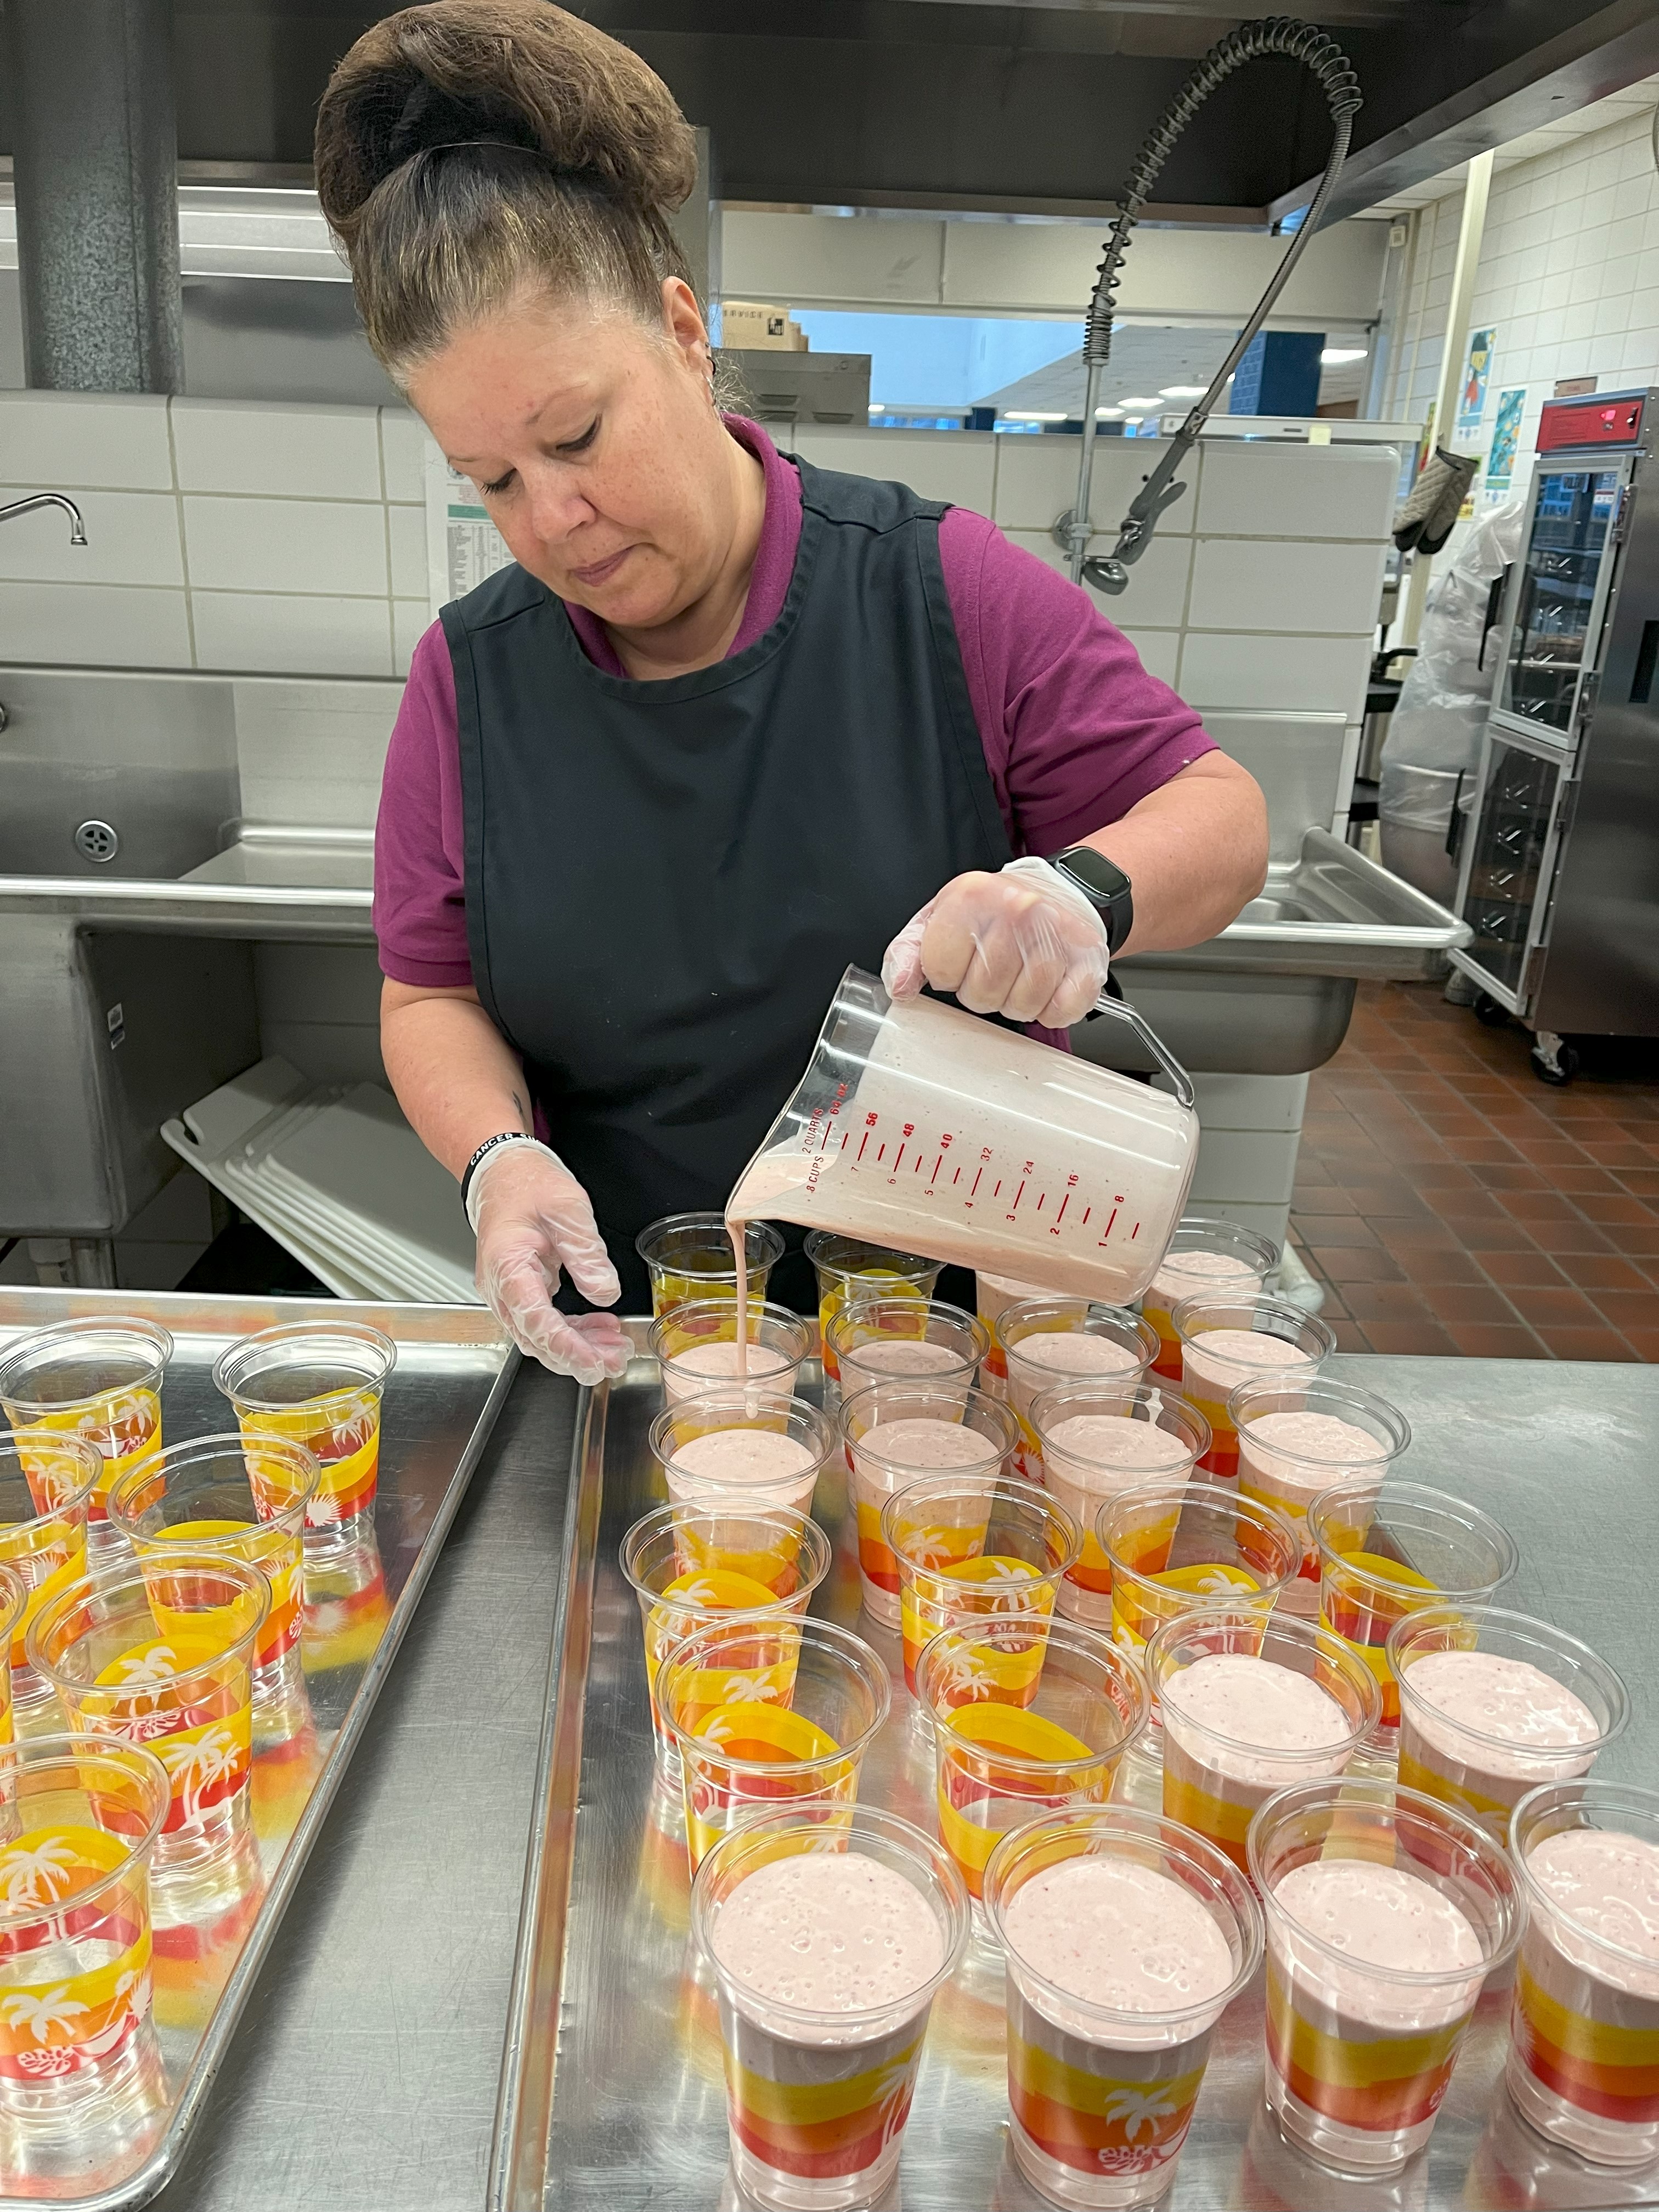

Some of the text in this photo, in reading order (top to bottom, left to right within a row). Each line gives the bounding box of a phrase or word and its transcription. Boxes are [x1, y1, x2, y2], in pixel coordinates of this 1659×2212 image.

[830, 1100, 842, 1115] 64
[804, 1107, 823, 1146] QUARTS
[866, 1112, 878, 1126] 56
[902, 1123, 915, 1137] 48
[940, 1133, 953, 1149] 40
[470, 1133, 513, 1166] CANCER
[980, 1147, 994, 1161] 32
[809, 1156, 824, 1183] CUPS
[1023, 1160, 1035, 1175] 24
[1068, 1174, 1079, 1187] 16
